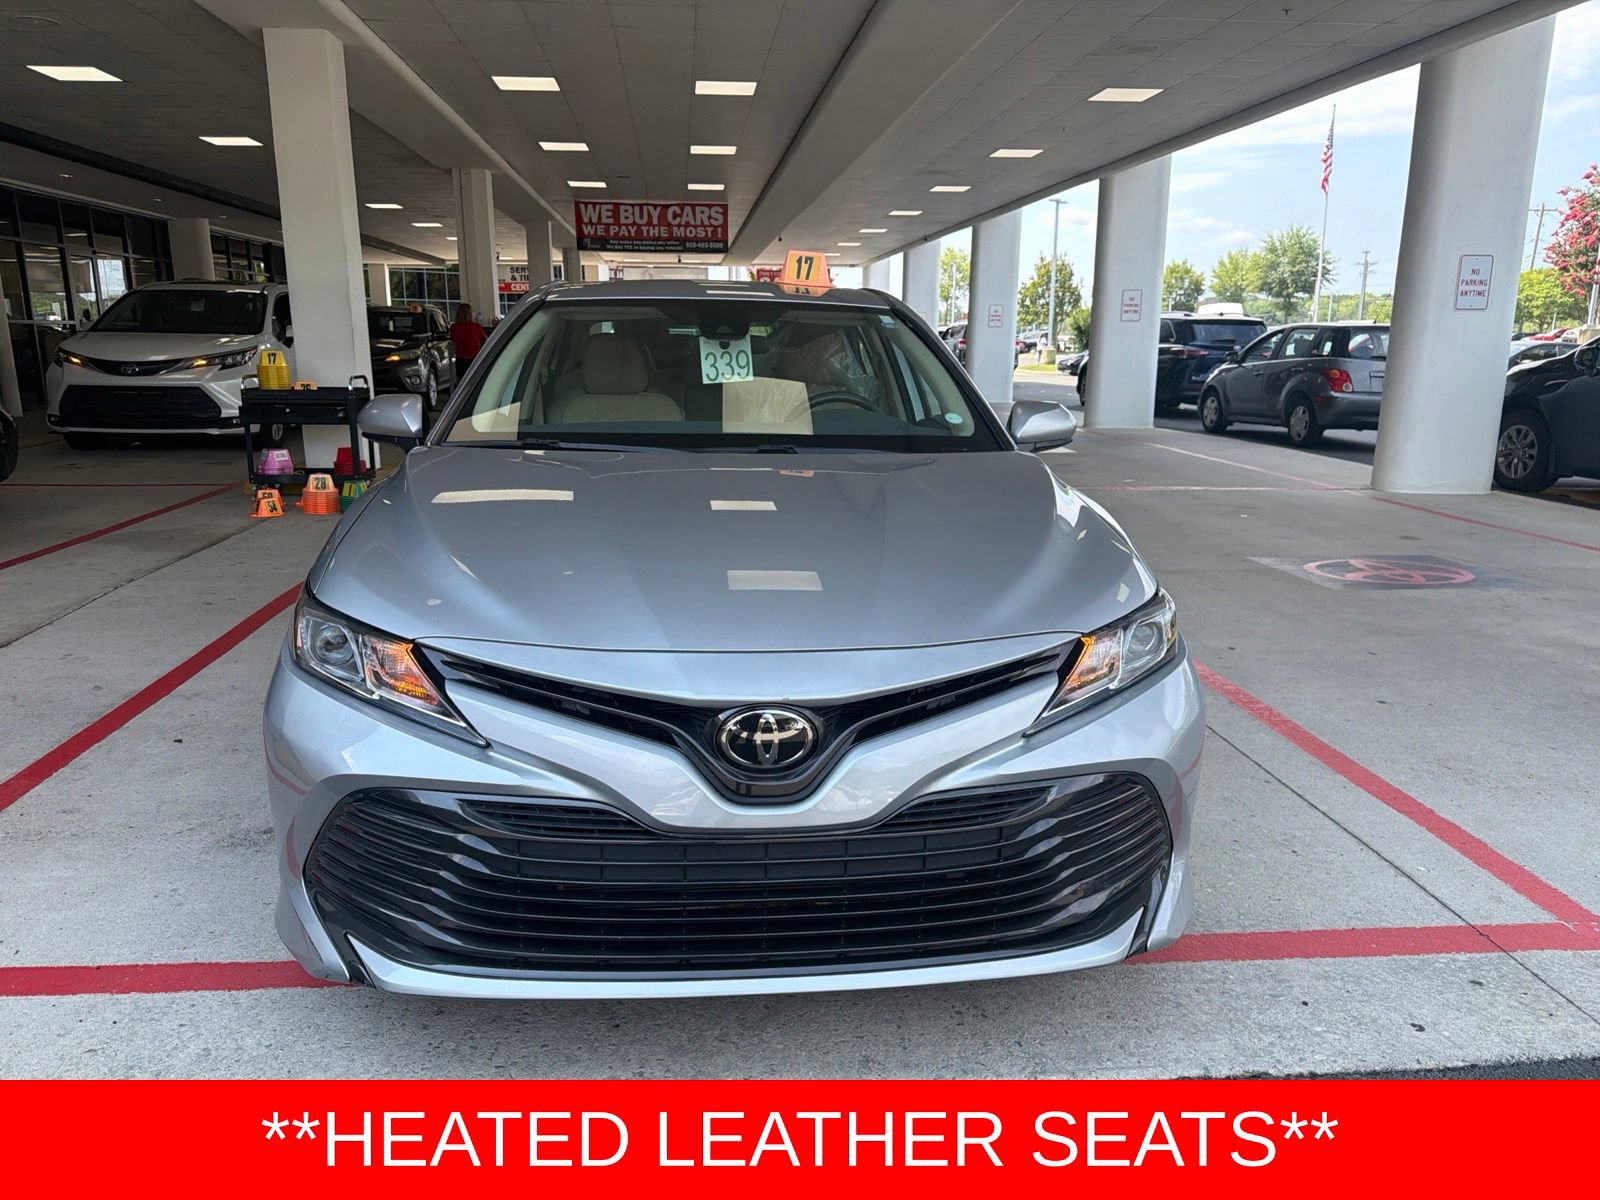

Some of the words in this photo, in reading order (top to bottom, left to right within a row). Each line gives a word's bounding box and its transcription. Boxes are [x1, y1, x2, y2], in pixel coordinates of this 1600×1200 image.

[579, 203, 614, 224] WE
[619, 204, 664, 225] BUY
[667, 205, 724, 226] CARS
[582, 224, 608, 236] WE
[609, 225, 637, 237] PAY
[641, 226, 669, 237] THE
[673, 226, 713, 238] MOST
[717, 227, 722, 238] !
[796, 255, 814, 280] 17
[1471, 268, 1480, 276] NO
[1460, 278, 1488, 287] PARKING
[1459, 289, 1487, 297] ANYTIME
[267, 352, 277, 365] 17
[705, 349, 751, 382] 339
[314, 476, 327, 490] 28
[267, 500, 278, 513] 54
